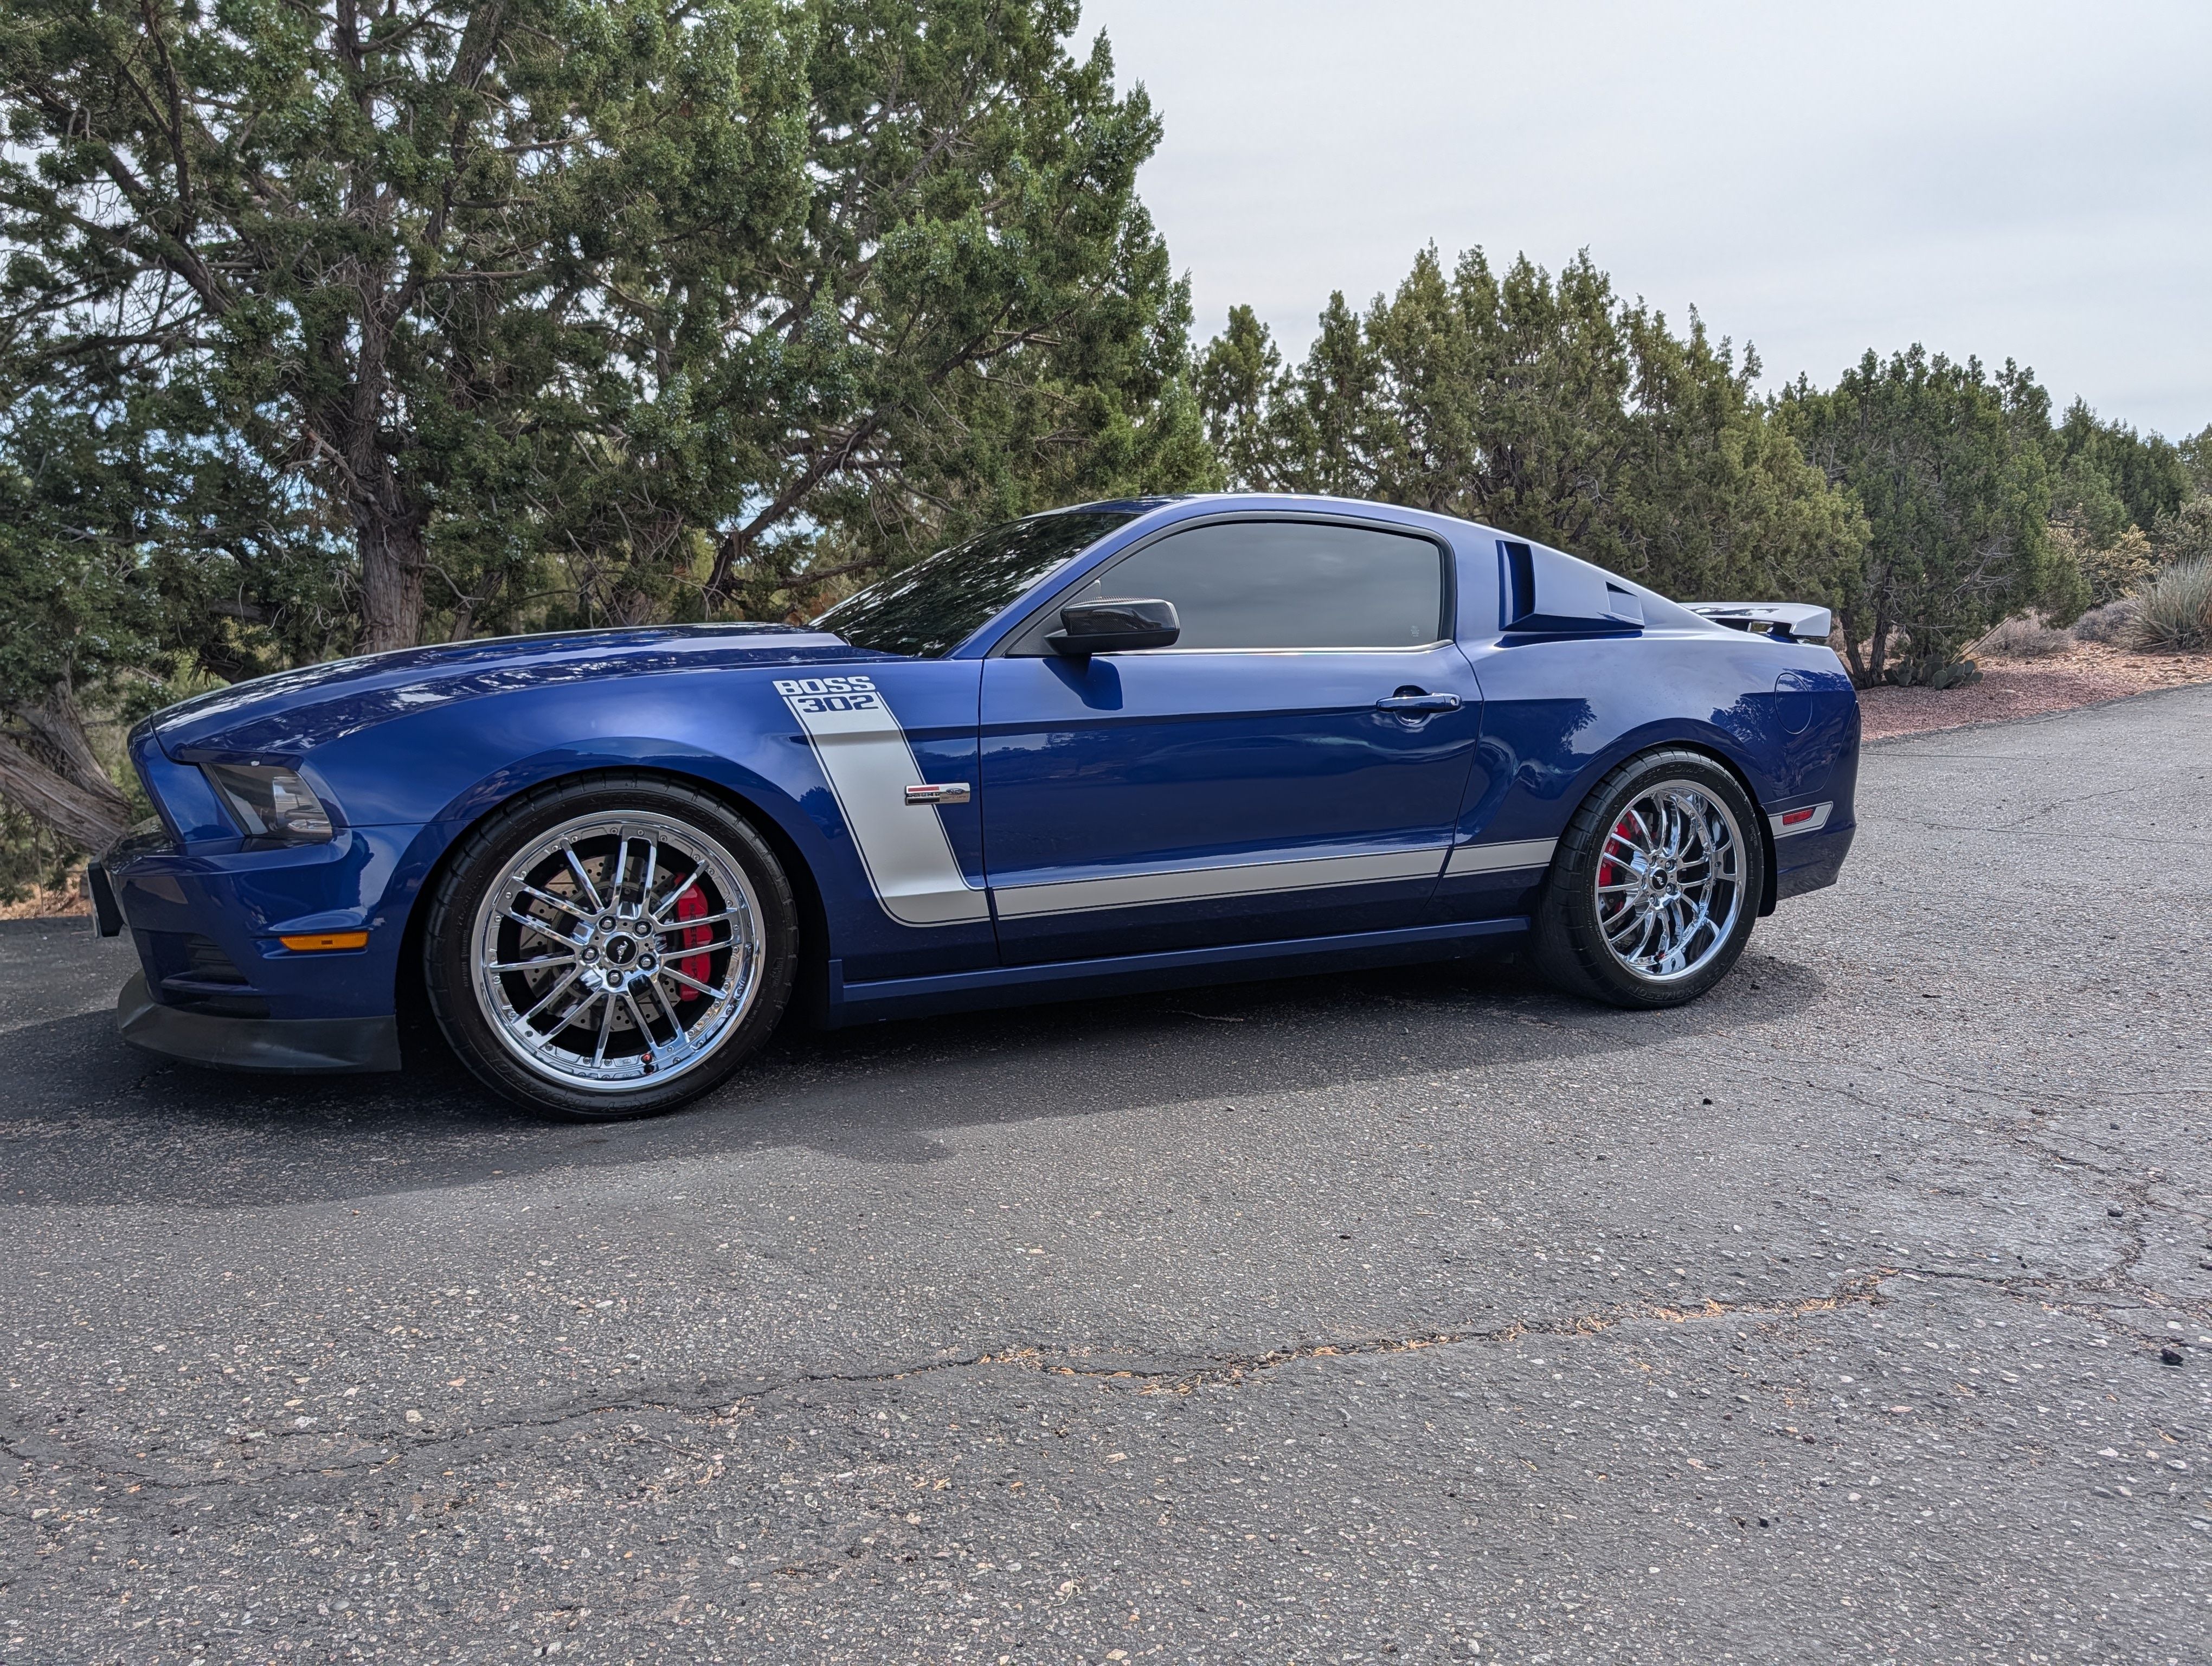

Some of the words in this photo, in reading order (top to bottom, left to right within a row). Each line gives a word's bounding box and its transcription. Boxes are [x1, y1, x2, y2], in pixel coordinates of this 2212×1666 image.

[772, 676, 876, 695] BOSS
[798, 695, 879, 713] 302
[602, 1086, 687, 1112] MICKEY
